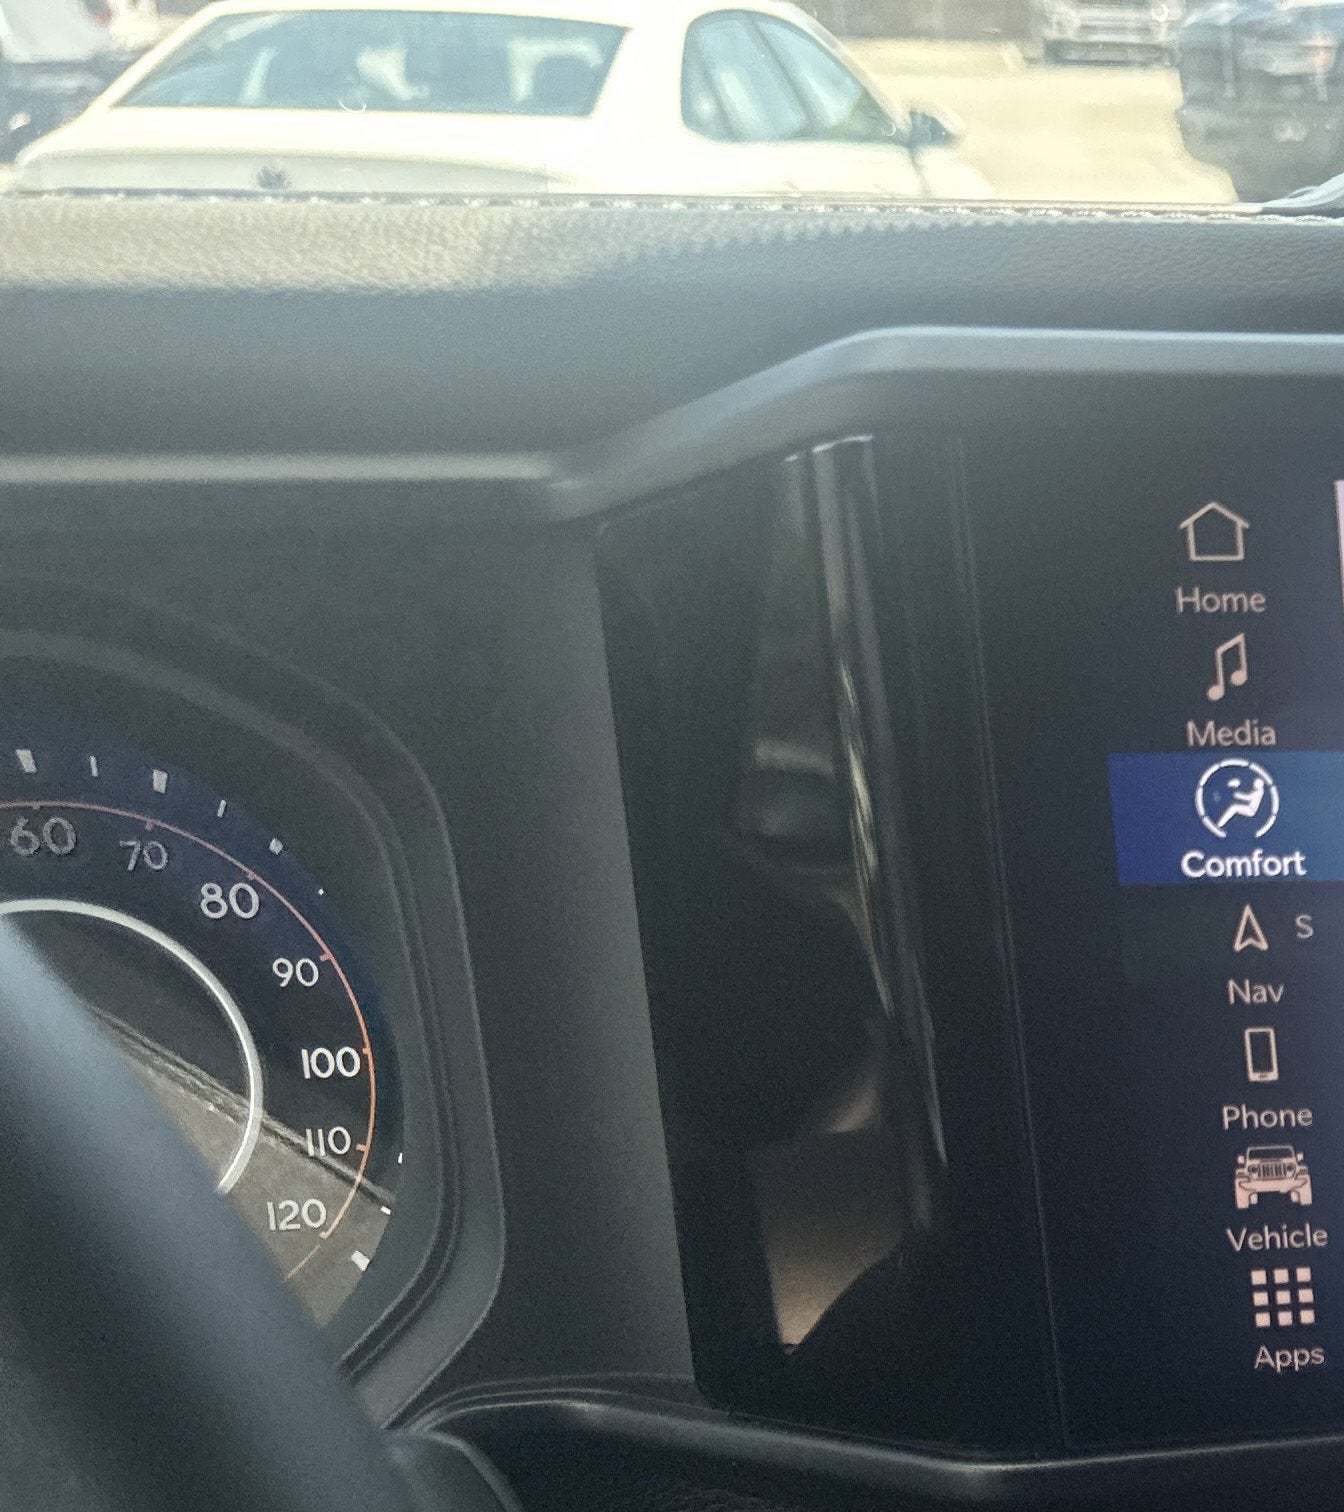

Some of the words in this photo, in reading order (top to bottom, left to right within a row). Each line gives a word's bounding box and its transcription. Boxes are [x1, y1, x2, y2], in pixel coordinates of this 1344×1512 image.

[1176, 586, 1267, 614] Home
[1186, 719, 1277, 747] Media
[9, 816, 77, 859] 60
[119, 839, 170, 873] 70
[1180, 848, 1307, 881] Comfort
[199, 881, 261, 921] 80
[1294, 914, 1314, 939] S
[271, 957, 320, 988] 90
[1226, 979, 1285, 1005] Nav
[300, 1046, 362, 1080] 100
[1221, 1104, 1314, 1131] Phone
[304, 1126, 351, 1158] 110
[266, 1199, 328, 1232] 120
[1225, 1223, 1329, 1252] Vehicle
[1253, 1342, 1326, 1374] Apps
